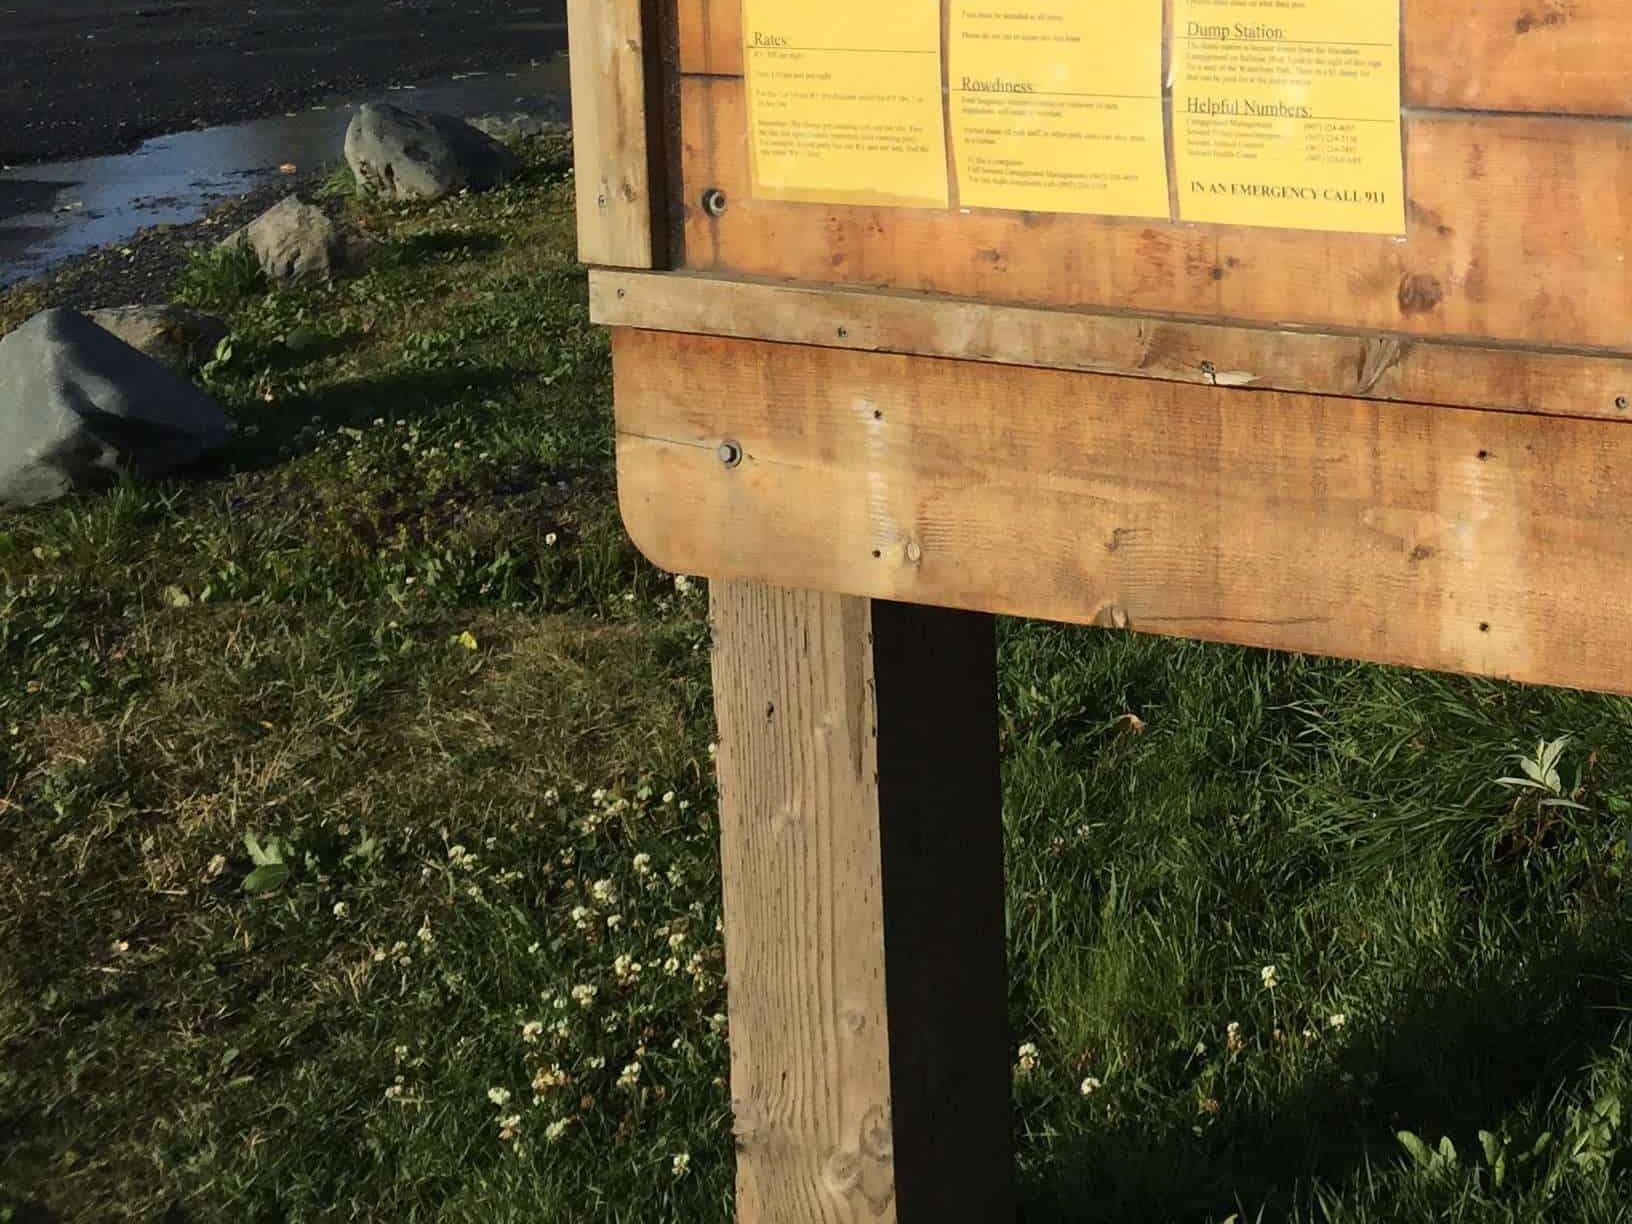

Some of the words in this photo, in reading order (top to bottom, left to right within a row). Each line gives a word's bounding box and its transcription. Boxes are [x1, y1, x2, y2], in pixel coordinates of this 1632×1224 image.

[1187, 22, 1231, 41] Dump
[1234, 23, 1286, 40] Station:
[1187, 97, 1240, 116] Helpful
[1244, 100, 1313, 119] Numbers:
[1191, 181, 1205, 192] IN
[1209, 182, 1227, 193] AN
[1231, 183, 1318, 200] EMERGENCY
[1323, 189, 1361, 203] CALL
[1364, 191, 1385, 205] 911
